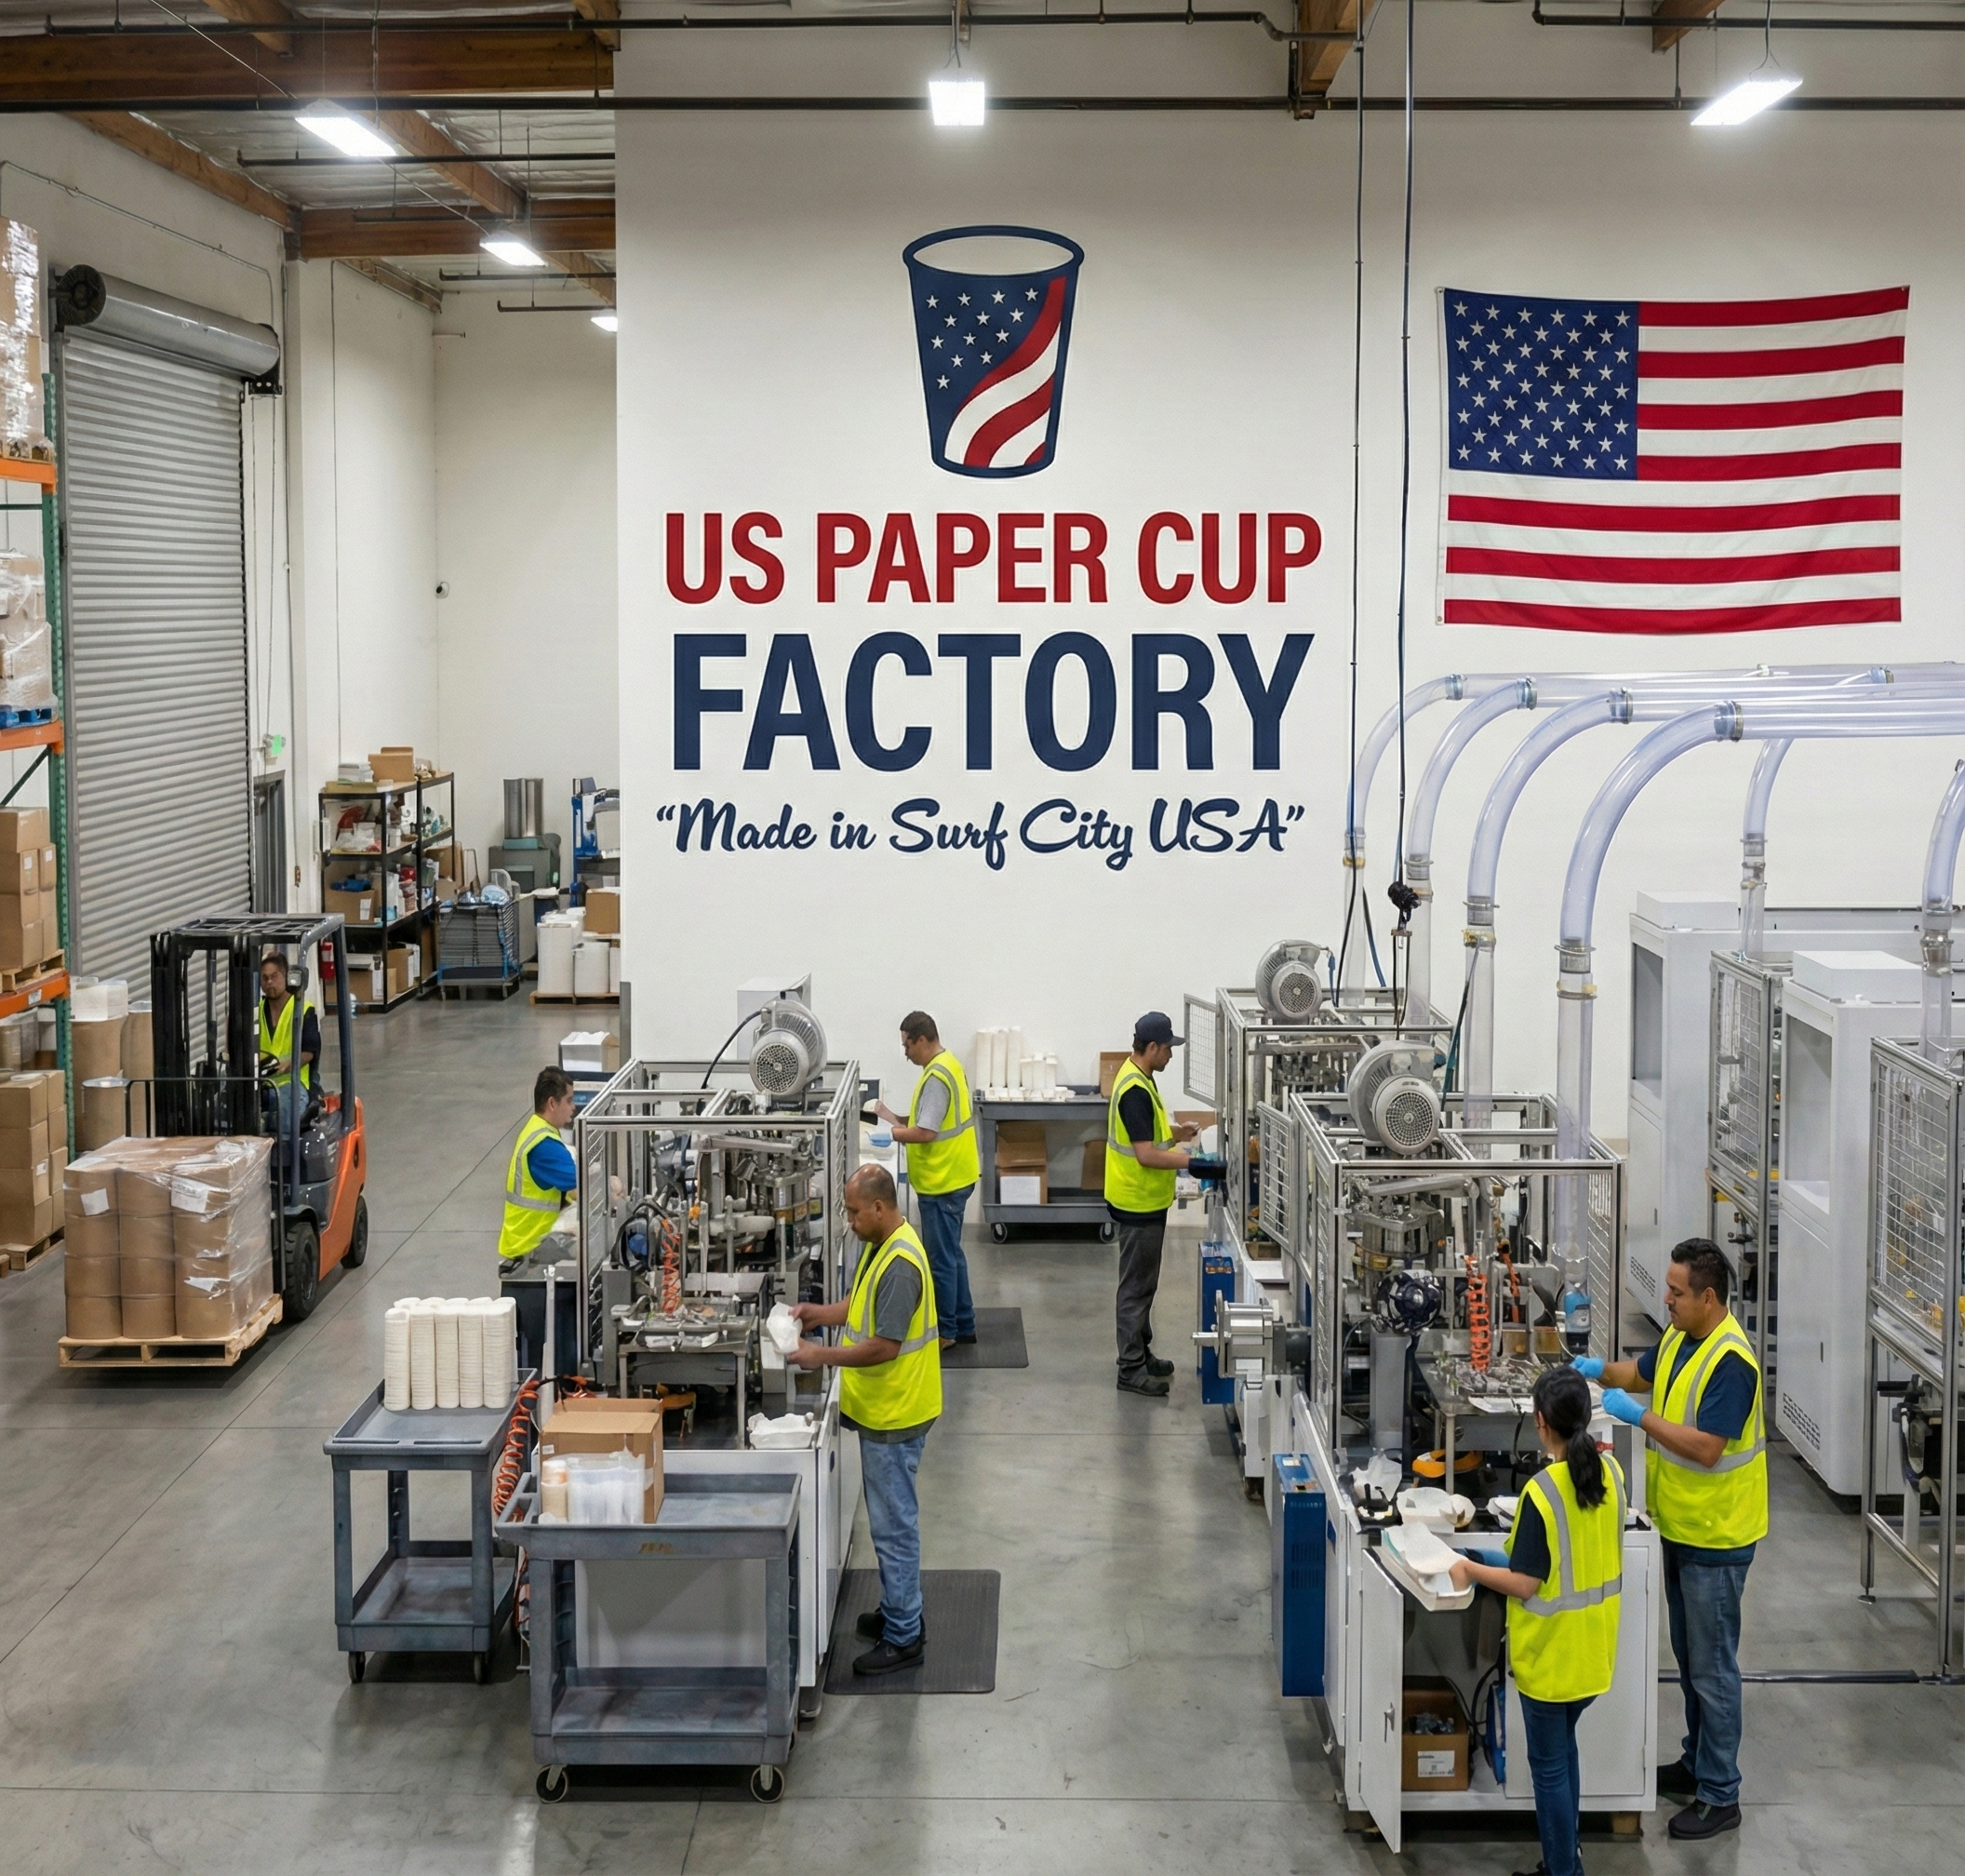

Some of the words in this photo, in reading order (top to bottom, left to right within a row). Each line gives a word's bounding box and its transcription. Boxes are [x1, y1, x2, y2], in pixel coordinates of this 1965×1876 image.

[665, 511, 785, 605] US
[816, 512, 1108, 604] PAPER
[1137, 511, 1322, 605] CUP
[673, 631, 1316, 772] FACTORY
[656, 797, 818, 853] “Made
[830, 811, 877, 851] in
[889, 797, 1009, 871] Surf
[1019, 797, 1134, 872] City
[1149, 797, 1305, 853] USA”
